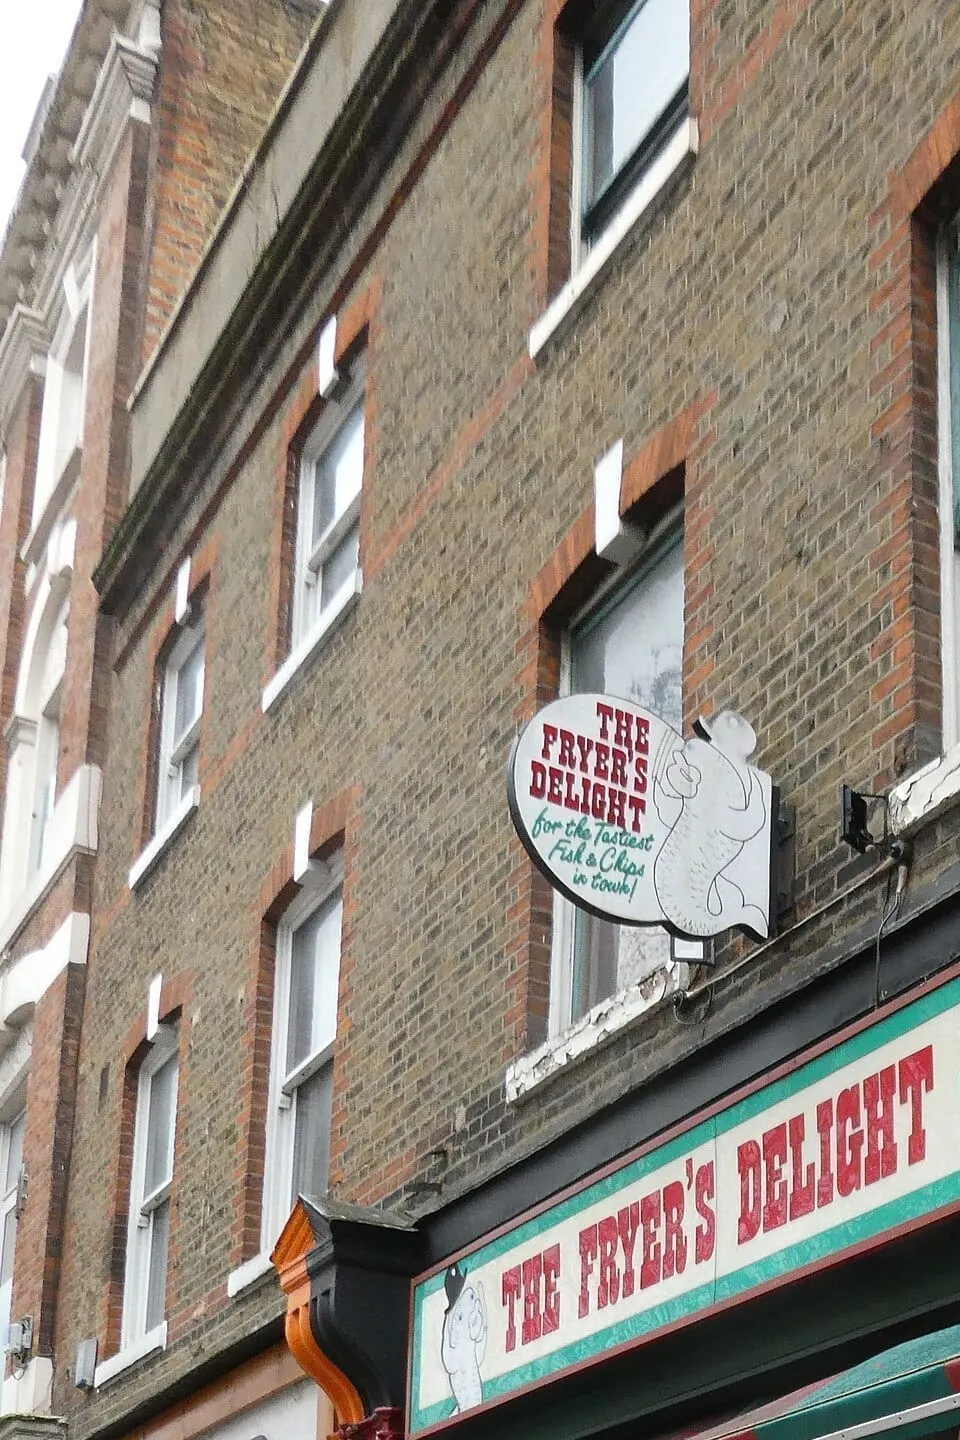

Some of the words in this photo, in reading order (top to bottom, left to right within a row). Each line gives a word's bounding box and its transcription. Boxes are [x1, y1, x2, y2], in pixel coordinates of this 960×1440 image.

[596, 702, 650, 755] THE
[541, 723, 648, 795] FRYER'S
[529, 760, 646, 834] DELIGHT
[532, 807, 562, 839] for
[564, 814, 592, 842] the
[594, 820, 655, 852] Tastiest
[548, 838, 584, 866] Fish
[585, 852, 598, 868] &
[599, 849, 646, 878] Chips
[572, 868, 589, 886] in
[502, 1243, 562, 1353] THE
[578, 1157, 716, 1320] FRYER'S
[737, 1043, 936, 1246] DELIGHT
